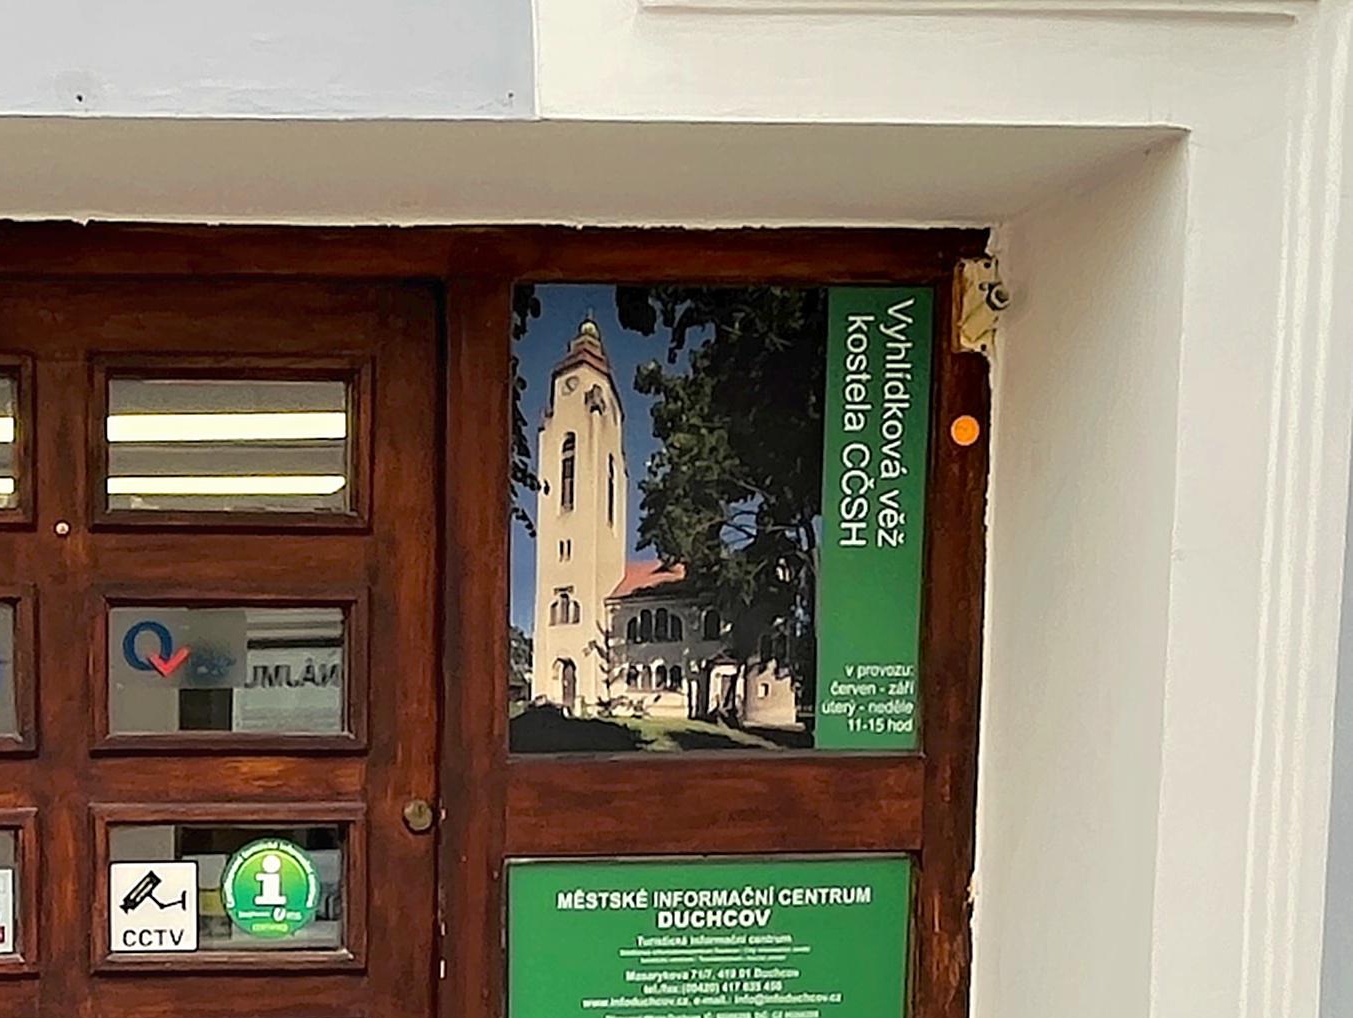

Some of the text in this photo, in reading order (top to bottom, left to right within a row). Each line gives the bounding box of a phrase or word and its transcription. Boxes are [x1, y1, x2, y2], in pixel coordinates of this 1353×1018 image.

[839, 315, 875, 547] kostela CČSH
[877, 298, 915, 547] Vyhlídková věž
[557, 887, 872, 909] MĚSTSKÉ INFORMAČNÍ CENTRUM
[658, 909, 771, 929] DUCHCOV
[122, 929, 185, 946] CCTV
